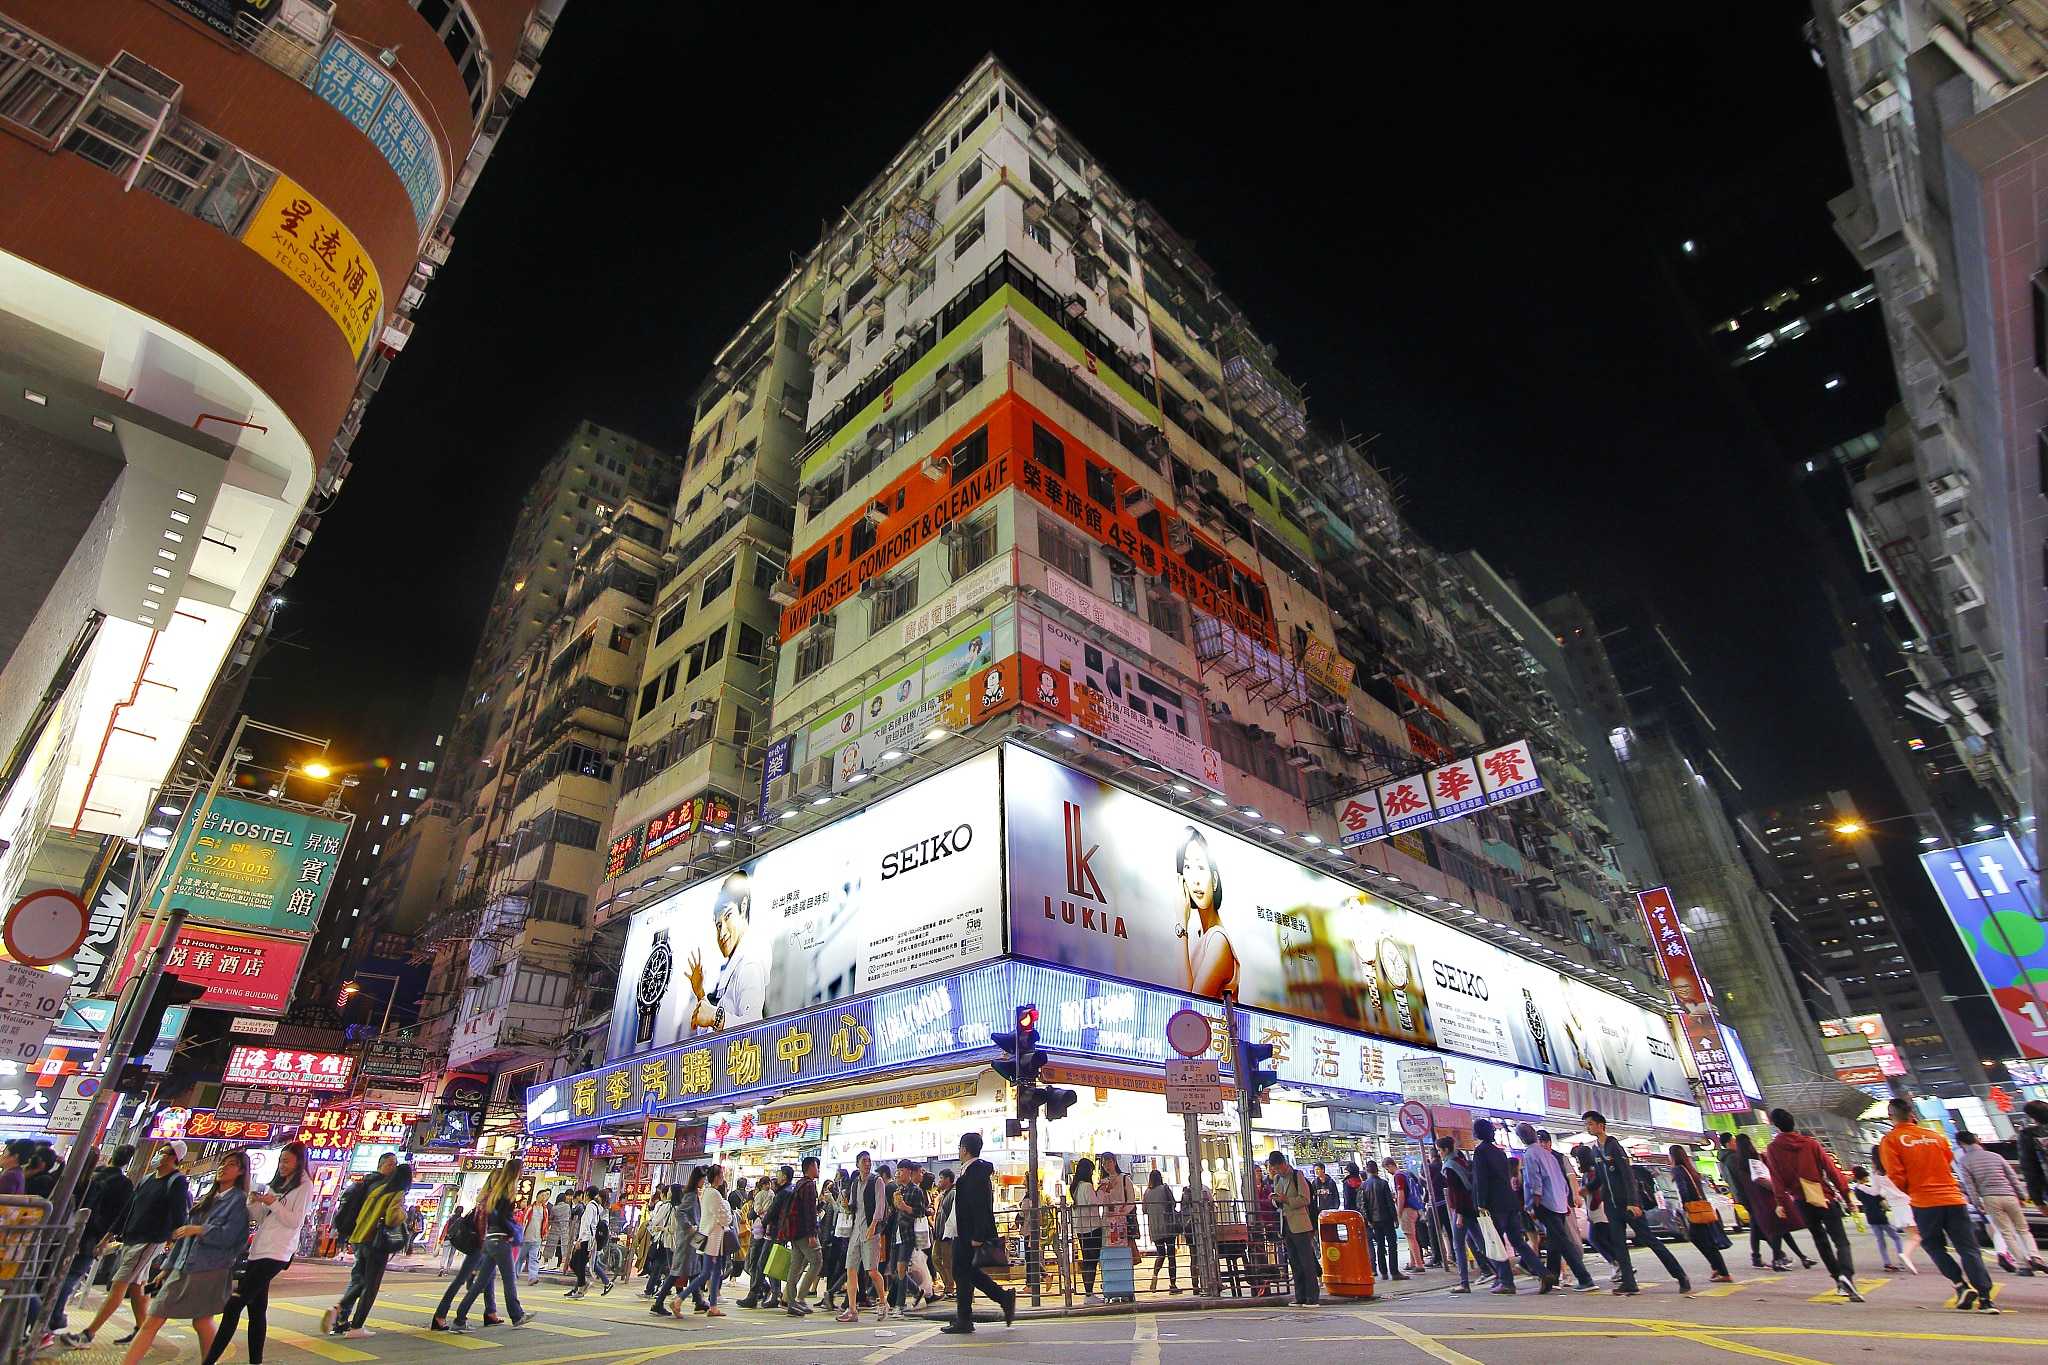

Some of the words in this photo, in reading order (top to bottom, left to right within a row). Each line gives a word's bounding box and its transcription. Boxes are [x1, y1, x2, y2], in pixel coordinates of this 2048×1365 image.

[280, 198, 378, 325] 星遠酒店
[271, 231, 310, 265] XING
[312, 262, 345, 300] YUAN
[343, 300, 365, 340] HOTEL
[1022, 458, 1104, 534] 榮華旅館
[811, 574, 854, 617] HOSTEL
[857, 524, 920, 584] COMFORT
[921, 514, 932, 539] &
[933, 482, 982, 529] CLEAN
[982, 457, 1009, 496] 4/F
[1047, 623, 1080, 647] SONY
[190, 818, 218, 830] YET
[193, 808, 221, 821] SNG
[218, 816, 295, 848] HOSTEL
[880, 823, 974, 882] SEIKO
[203, 854, 237, 870] 2770
[240, 861, 270, 876] 1015
[194, 886, 218, 897] YUEN
[218, 890, 237, 901] KING
[238, 894, 273, 907] BUILDING
[286, 857, 328, 917] 賓館
[1043, 895, 1129, 940] LUKIA
[191, 940, 225, 951] HOURLY
[226, 944, 252, 955] HOTEL
[7, 964, 45, 980] Saturdays
[1432, 959, 1489, 1002] SEIKO
[19, 991, 34, 1000] pm
[206, 985, 224, 995] UEN
[224, 987, 244, 997] KING
[243, 989, 280, 1001] BUILDING
[35, 995, 56, 1013] 10
[17, 1041, 37, 1059] 10
[244, 1048, 343, 1074] 海龍賓館
[571, 1012, 874, 1118] 荷李活購物中心
[227, 1067, 258, 1079] HOI
[259, 1068, 300, 1081] LOON
[302, 1073, 349, 1085] HOTEL
[1205, 1074, 1217, 1083] 10
[1209, 1101, 1221, 1111] 10
[663, 1140, 669, 1148] 7
[662, 1152, 672, 1160] 12
